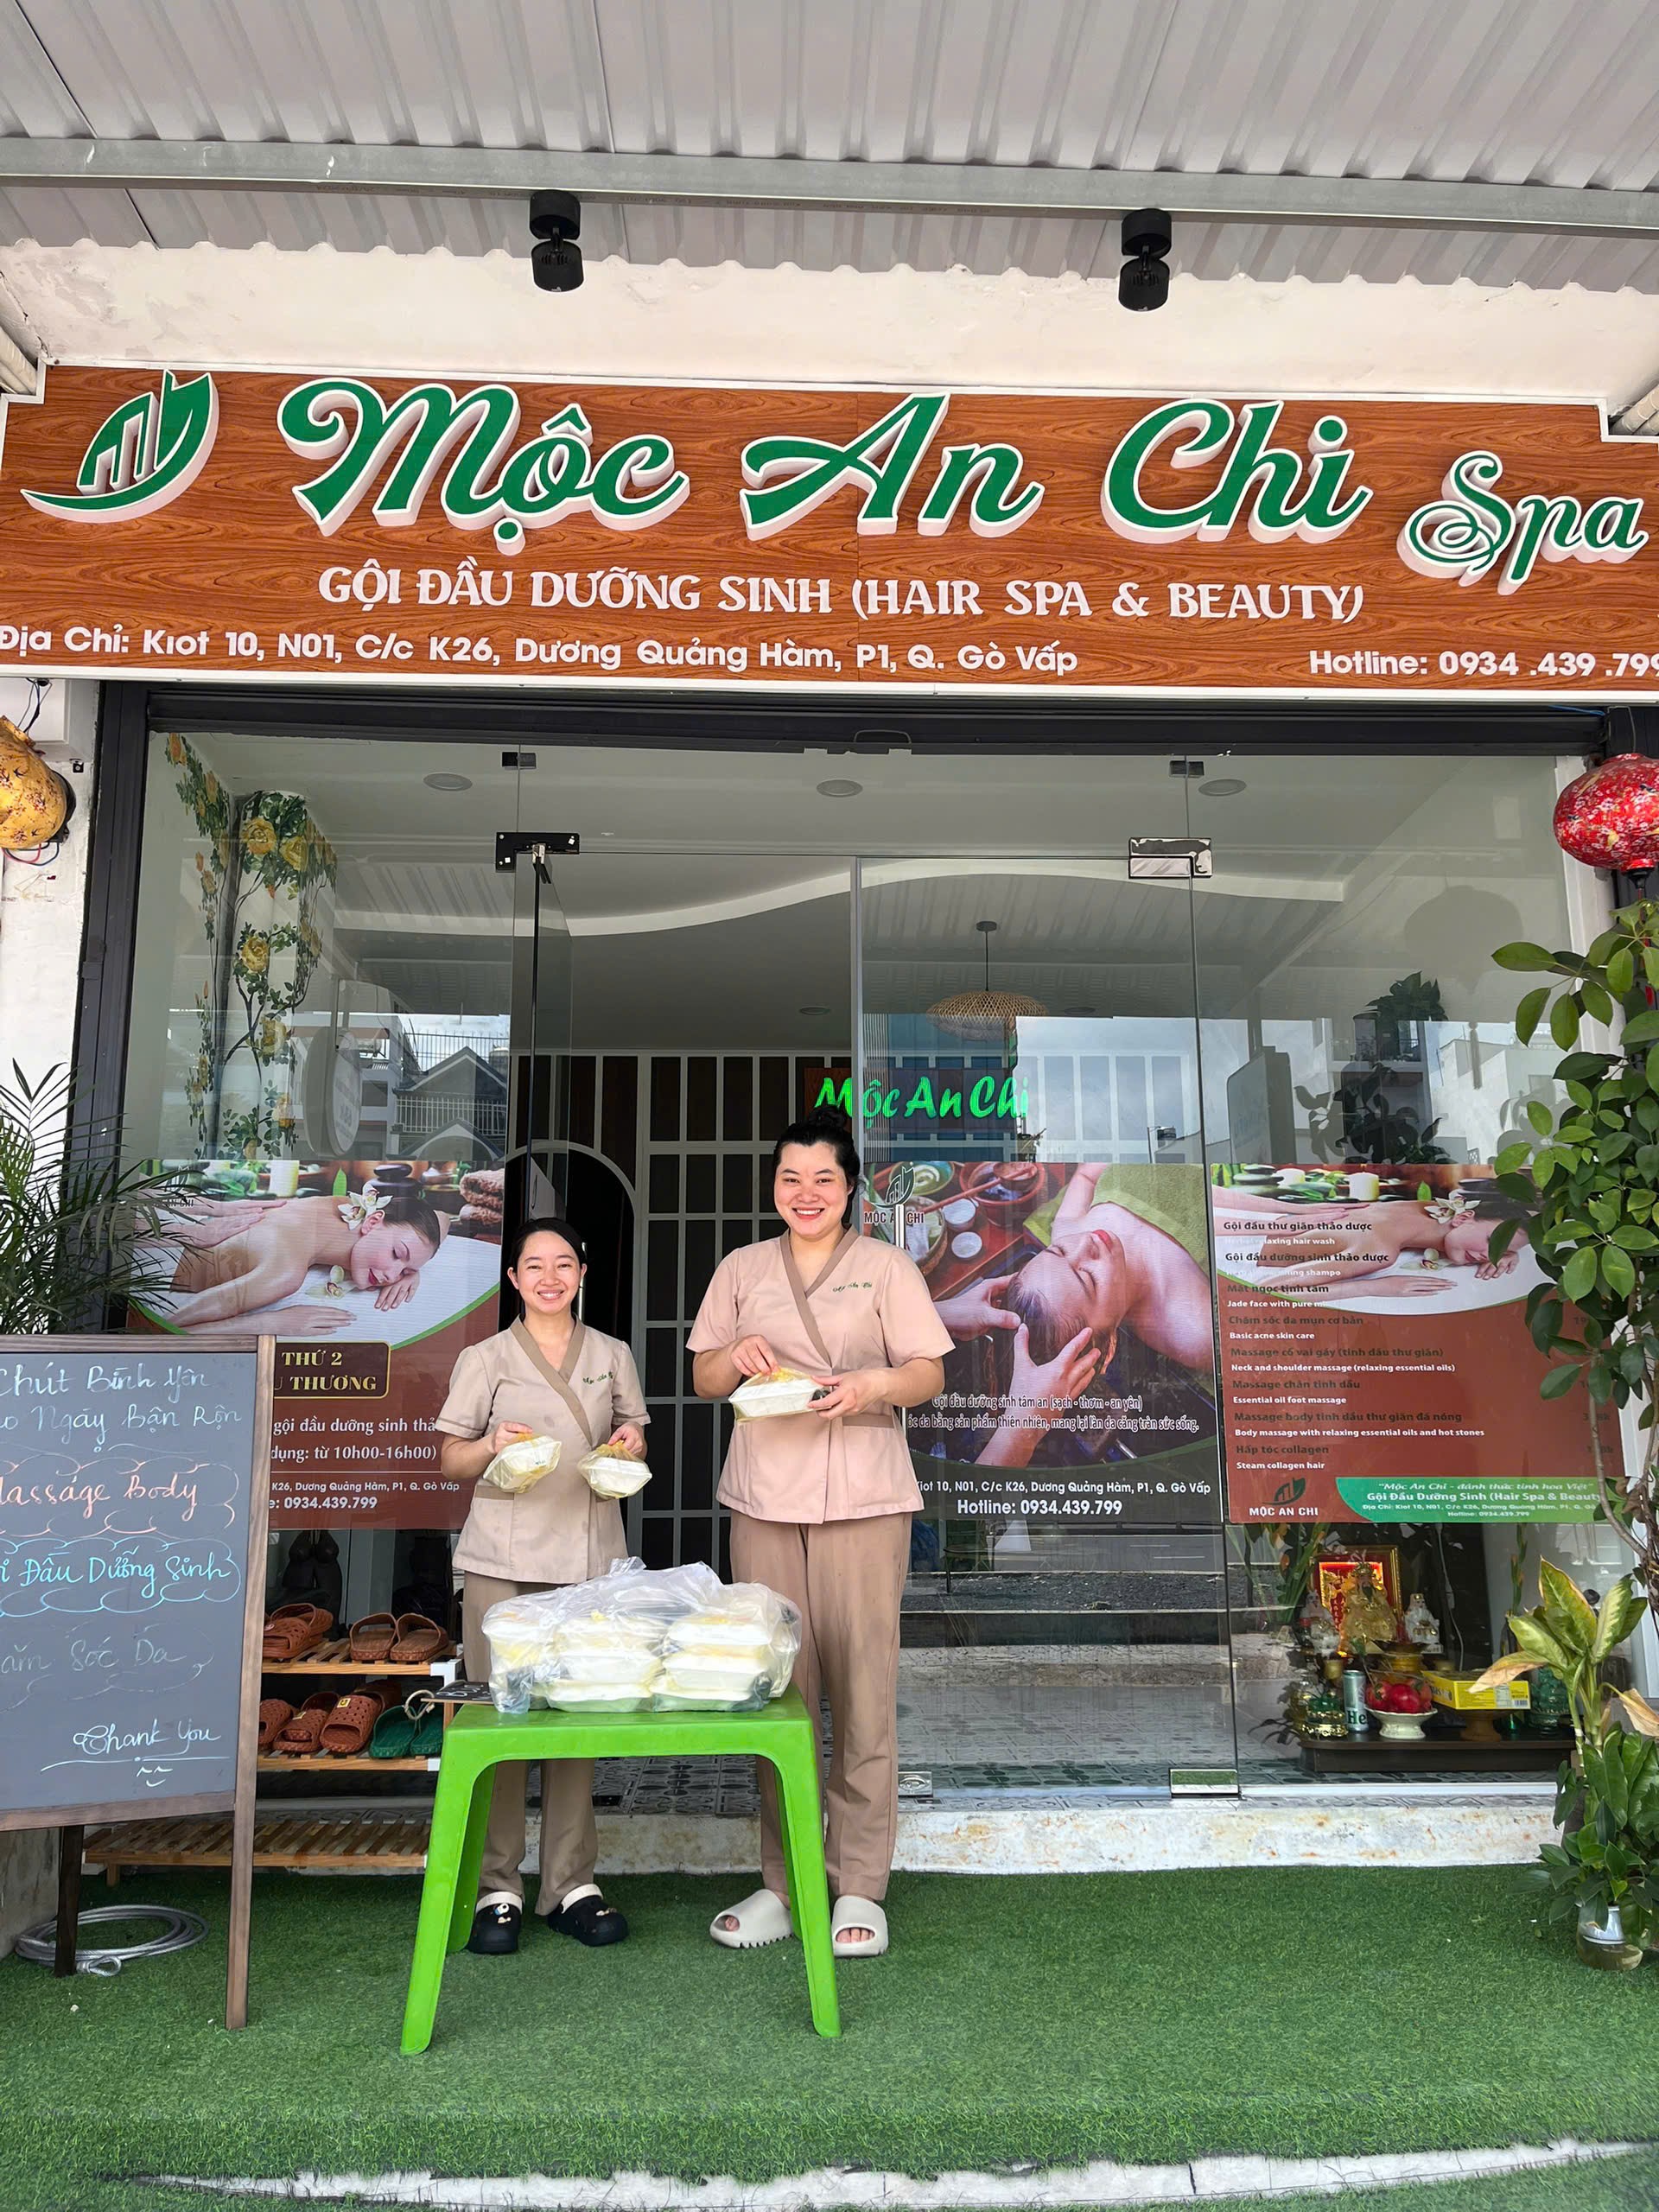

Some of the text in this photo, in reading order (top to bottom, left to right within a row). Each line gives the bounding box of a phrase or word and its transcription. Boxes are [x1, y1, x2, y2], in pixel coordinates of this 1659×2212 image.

[277, 378, 1649, 596] Mộc An Chi Spa
[318, 554, 1364, 625] GỘI ĐẦU DƯỠNG SINH (HAIR SPA & BEAUTY)
[0, 626, 52, 658] Địa
[64, 623, 130, 654] Chỉ:
[226, 632, 266, 663] 10,
[277, 634, 343, 664] N01,
[355, 634, 414, 662] C/c
[429, 637, 501, 668] K26,
[515, 638, 621, 672] Dương
[639, 635, 749, 673] Quảng
[760, 638, 843, 671] Hàm,
[856, 645, 899, 675] P1,
[906, 644, 946, 673] Q.
[957, 642, 1006, 672] Gò
[1014, 639, 1079, 678] Vấp
[1310, 648, 1428, 677] Hotline:
[1439, 651, 1519, 677] 0934
[1529, 652, 1597, 677] .439
[814, 1076, 1029, 1129] Mộc An Chi
[864, 1211, 925, 1226] MỘC CHI
[282, 1349, 342, 1366] THỨ 2
[1354, 1363, 1393, 1373] (relaxing
[1437, 1363, 1456, 1372] oils)
[290, 1375, 377, 1390] THƯƠNG
[999, 1394, 1016, 1408] sinh
[1018, 1395, 1035, 1408] tâm
[1037, 1397, 1048, 1408] an
[1110, 1397, 1122, 1408] an
[273, 1415, 435, 1436] gội đầu dưỡng sinh thả
[907, 1414, 918, 1428] óc
[918, 1414, 931, 1427] da
[998, 1414, 1020, 1428] thiên
[1022, 1415, 1050, 1431] nhiên,
[1051, 1416, 1076, 1432] mang
[1104, 1415, 1116, 1429] da
[315, 1446, 330, 1459] từ
[334, 1446, 437, 1460] 10h00-16h00)
[1267, 1461, 1305, 1470] collagen
[271, 1480, 460, 1493] K26, Dương Quảng Hàm, P1, Q. Gò Vấp
[917, 1479, 1211, 1495] iot 10, N01, C/c K26, Dương Quảng Hàm, P1, Q. Gò Vấp
[0, 1471, 198, 1522] assage Body
[284, 1497, 378, 1509] 0934.439.799
[1522, 1493, 1545, 1502] Spa
[957, 1499, 1122, 1516] Hotline: 0934.439.799
[1249, 1506, 1275, 1518] MỘC
[165, 1552, 232, 1581] Sinh
[71, 1637, 187, 1671] Sóc Da
[73, 1719, 222, 1756] Thank You
